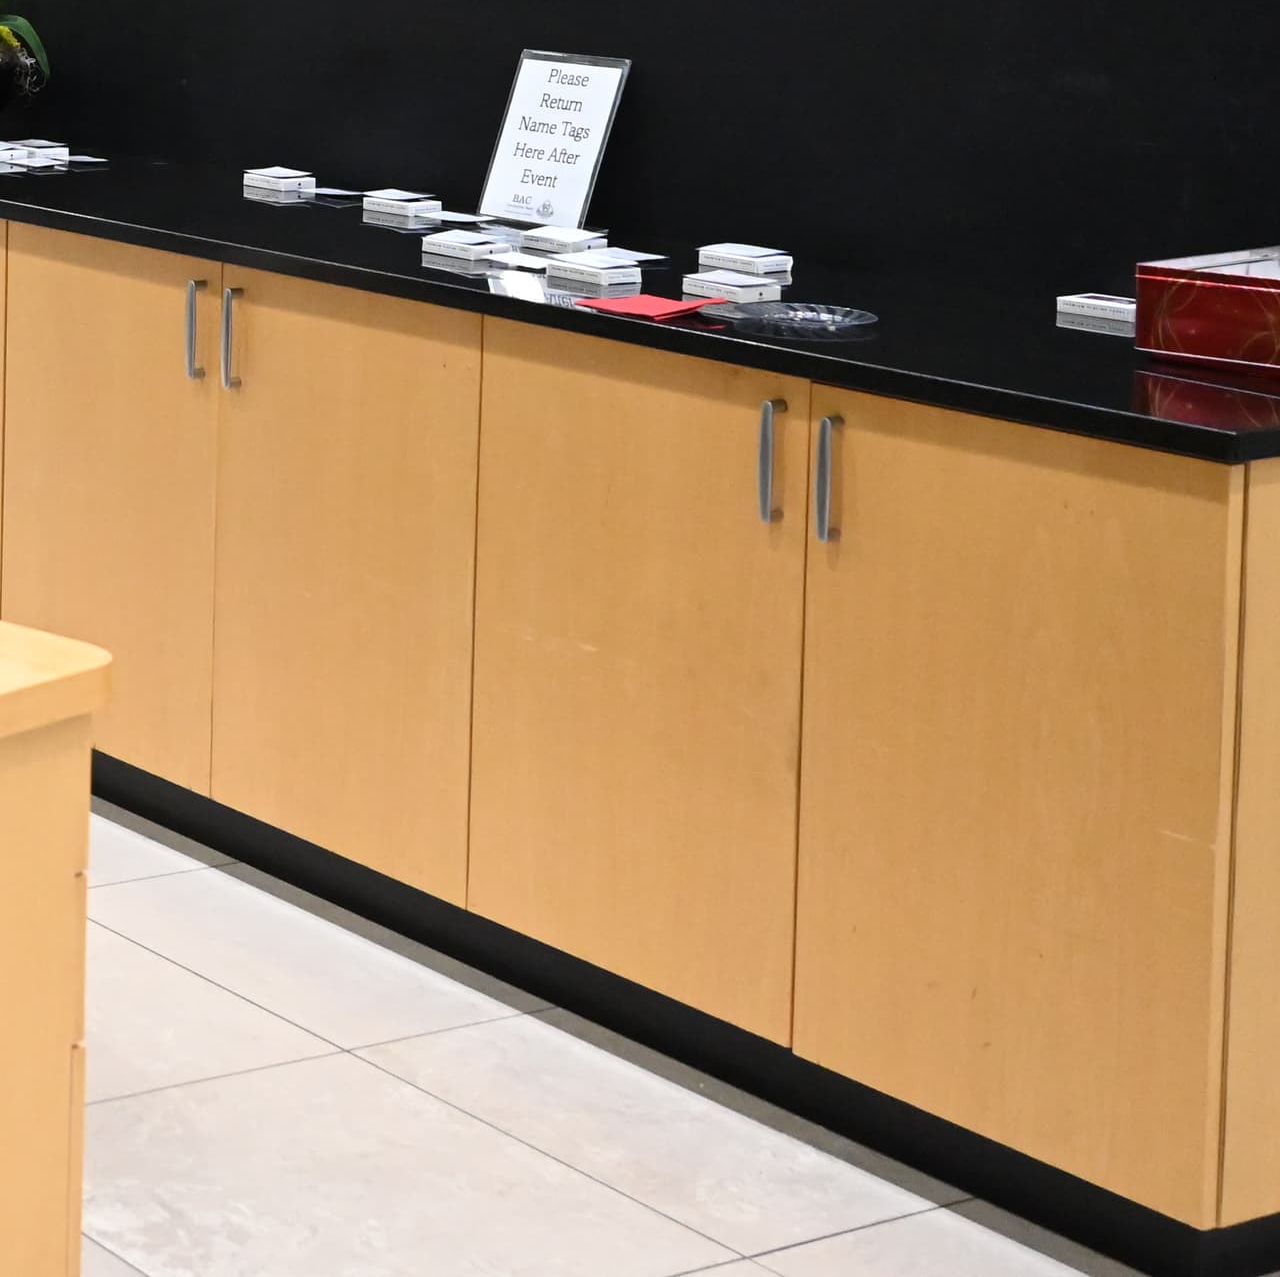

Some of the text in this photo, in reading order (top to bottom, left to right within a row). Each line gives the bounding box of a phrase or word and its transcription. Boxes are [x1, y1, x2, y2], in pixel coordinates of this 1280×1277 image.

[548, 68, 590, 87] Please
[540, 93, 583, 112] Return
[518, 115, 591, 142] Name Tags
[513, 142, 581, 165] Here After
[520, 169, 558, 188] Event
